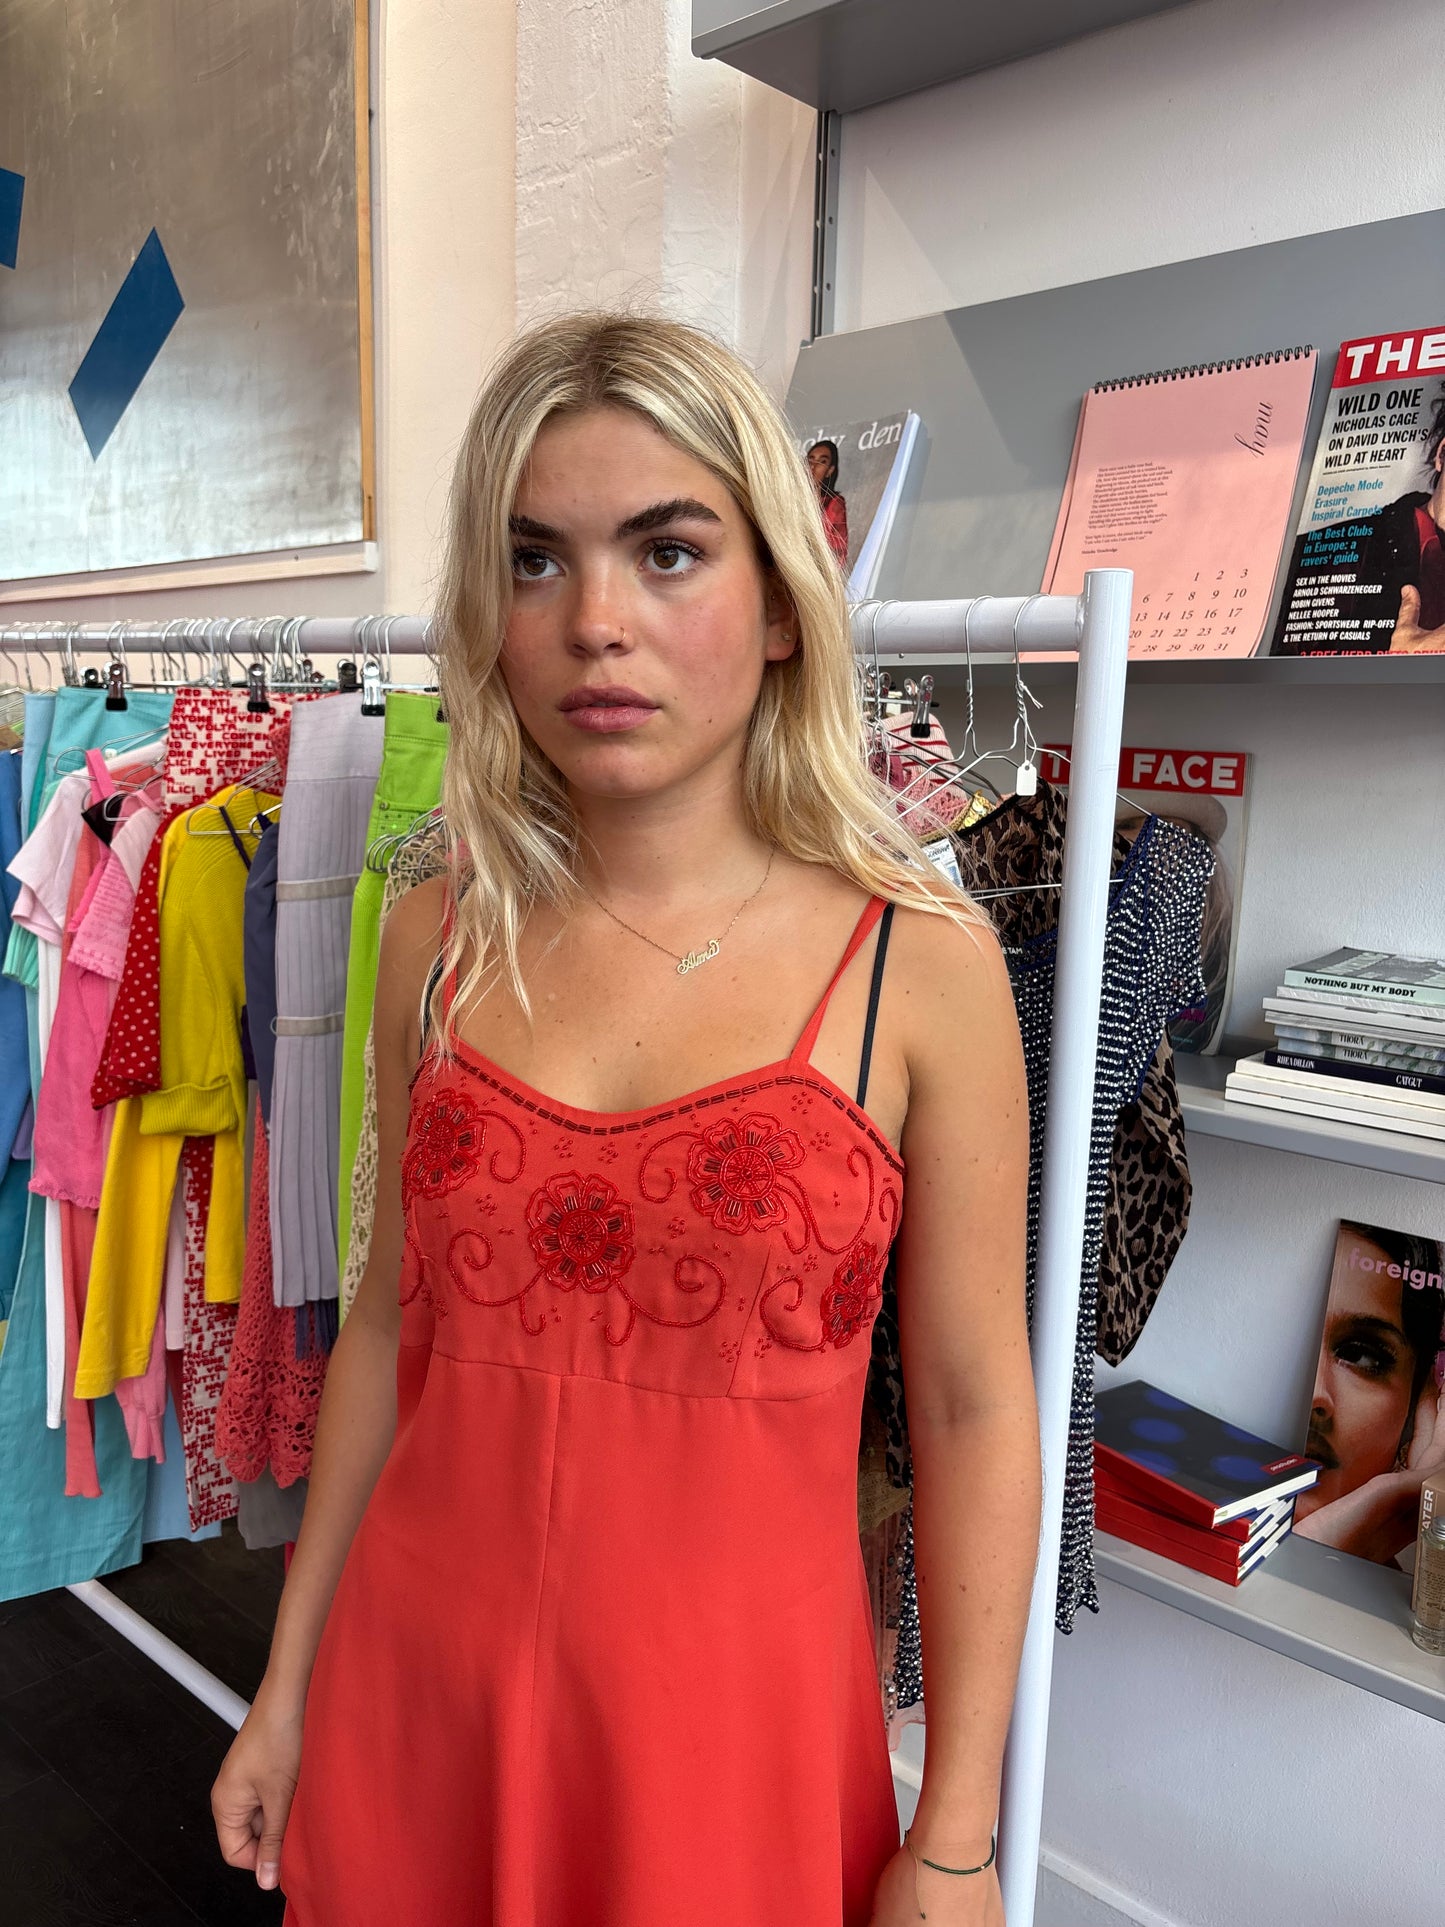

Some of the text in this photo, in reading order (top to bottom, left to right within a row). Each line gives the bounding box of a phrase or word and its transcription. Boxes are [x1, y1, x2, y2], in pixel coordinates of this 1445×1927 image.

[1347, 333, 1445, 379] THE
[1337, 388, 1424, 417] WILD ONE
[1332, 412, 1419, 434] NICHOLAS CAGE
[858, 422, 902, 450] den
[1329, 428, 1429, 450] ON DAVID LYNCH'S
[1324, 448, 1407, 469] WILD AT HEART
[1317, 479, 1384, 497] Depeche Mode
[1314, 497, 1348, 509] Erasure
[1311, 505, 1383, 522] Inspiral Carpets
[1307, 525, 1374, 541] The Best Clubs
[1303, 543, 1313, 554] in
[1314, 541, 1349, 554] Europe:
[1300, 552, 1359, 567] ravers' guide
[1216, 570, 1224, 580] 2
[1240, 568, 1248, 579] 3
[1296, 576, 1308, 586] SEX
[1317, 575, 1330, 584] THE
[1330, 573, 1357, 583] MOVIES
[1142, 588, 1247, 604] 6 7 8 9 10
[1293, 585, 1382, 597] ARNOLD SCHWARZENEGGER
[1291, 597, 1335, 609] ROBIN GIVENS
[1136, 608, 1242, 621] 13 14 15 16 17
[1288, 608, 1339, 620] NELLEE HOOPER
[1314, 619, 1360, 630] SPORTSWEAR
[1363, 619, 1395, 629] RIP-OFFS
[1129, 626, 1236, 639] 20 21 22 23 24
[1290, 634, 1301, 643] THE
[1302, 632, 1328, 642] RETURN
[1329, 632, 1339, 640] OF
[1340, 631, 1371, 641] CASUALS
[1166, 644, 1181, 652] 29
[1189, 643, 1205, 652] 30
[1214, 643, 1229, 651] 31
[1132, 753, 1239, 789] FACE
[1304, 976, 1417, 998] NOTHING BUT MY BODY
[1395, 1074, 1423, 1088] CATGUT
[1349, 1247, 1443, 1291] foreign
[1421, 1487, 1434, 1533] ATER
